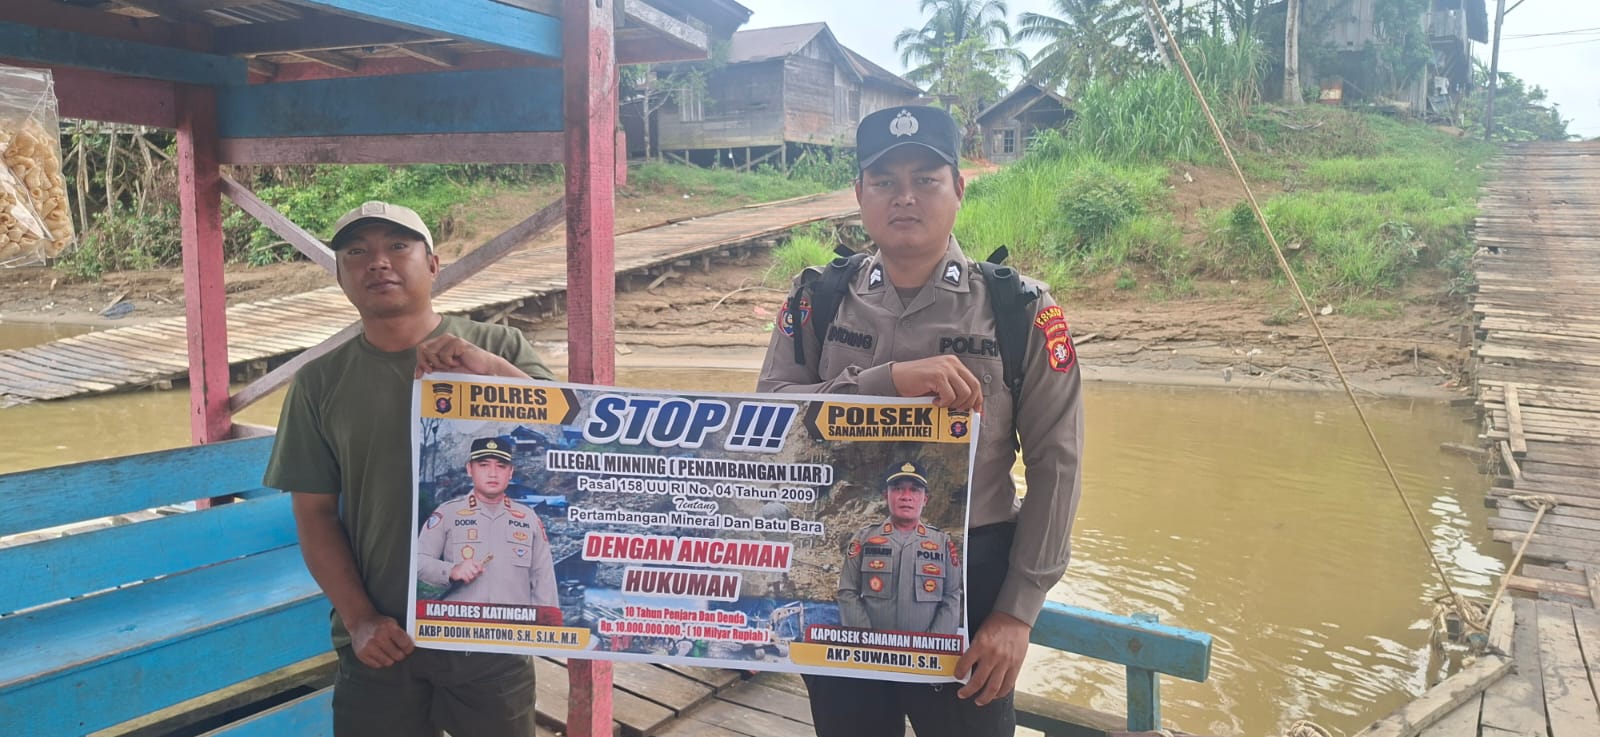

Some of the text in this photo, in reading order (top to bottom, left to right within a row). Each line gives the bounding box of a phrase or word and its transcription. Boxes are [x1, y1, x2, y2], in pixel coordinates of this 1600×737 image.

[470, 384, 548, 406] POLRES
[470, 404, 548, 421] KATINGAN
[588, 397, 728, 443] STOP
[827, 405, 934, 426] POLSEK
[828, 425, 932, 438] SANAMAN MANTIKEI
[549, 451, 601, 471] ILLEGAL
[604, 455, 666, 476] MINNING
[678, 459, 787, 481] PENAMBANGAN
[790, 465, 823, 483] LIAR
[580, 478, 813, 501] Pasal 158 UU RI No. 04 Tahun 2009
[676, 496, 717, 514] Tentang
[570, 508, 822, 533] Pertambangan Mineral Dan Batu Bara
[585, 535, 790, 569] DENGAN ANCAMAN
[917, 550, 944, 560] POLRI
[625, 569, 739, 598] HUKUMAN
[426, 603, 537, 622] KAPOLRES KATINGAN
[625, 606, 746, 625] 10 Tahun Penjara Dan Denda
[418, 624, 443, 637] AKBP
[443, 627, 471, 639] DODIK
[561, 632, 579, 645] M.H.
[600, 620, 614, 632] Rp.
[693, 627, 703, 637] 10
[704, 627, 732, 640] Milyar
[732, 630, 763, 643] Rupiah
[810, 627, 961, 653] KAPOLSEK SANAMAN MANTIKEI
[826, 647, 942, 671] AKP SUWARDI, S.H.
